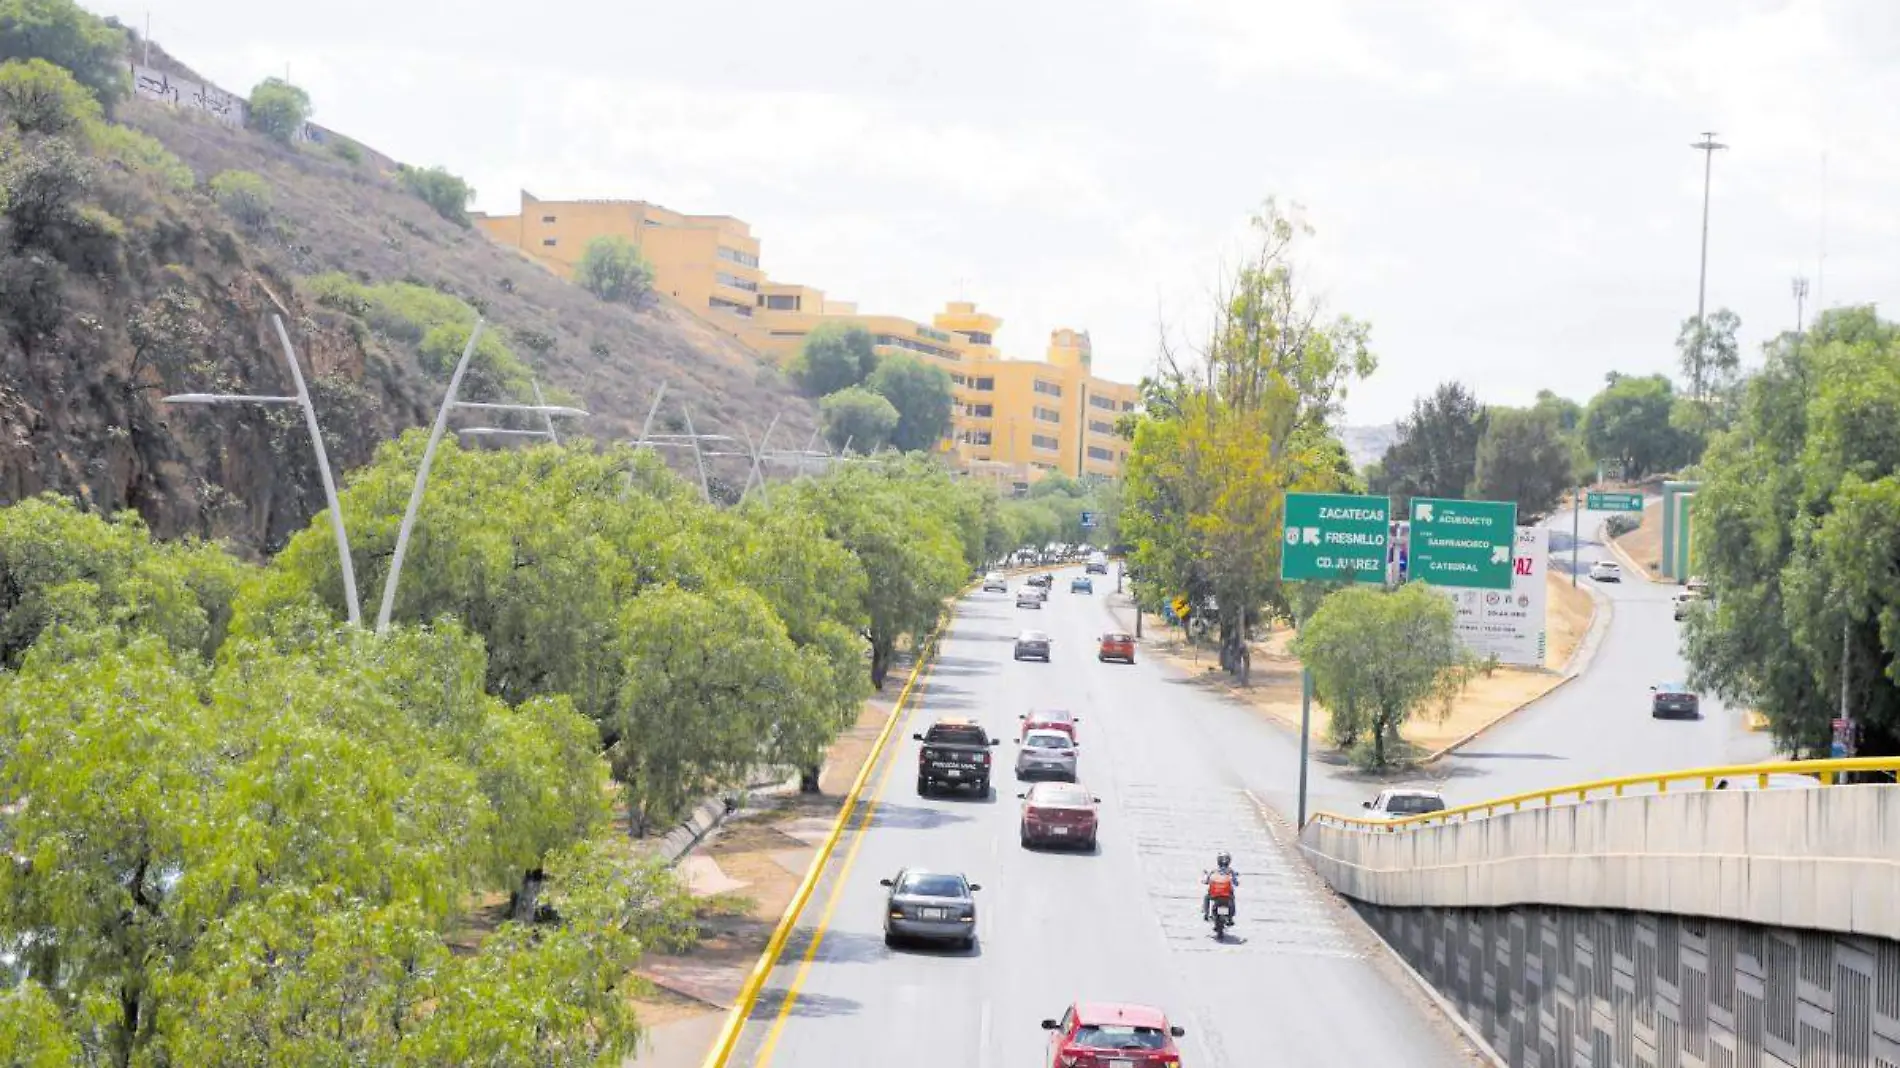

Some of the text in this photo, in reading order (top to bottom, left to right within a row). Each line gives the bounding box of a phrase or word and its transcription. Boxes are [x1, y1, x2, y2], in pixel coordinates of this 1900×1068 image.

[1319, 507, 1384, 521] ZACATECAS
[1325, 531, 1385, 545] FRESNILLO
[1429, 561, 1478, 572] CATEDRAL
[1513, 557, 1533, 576] AZ
